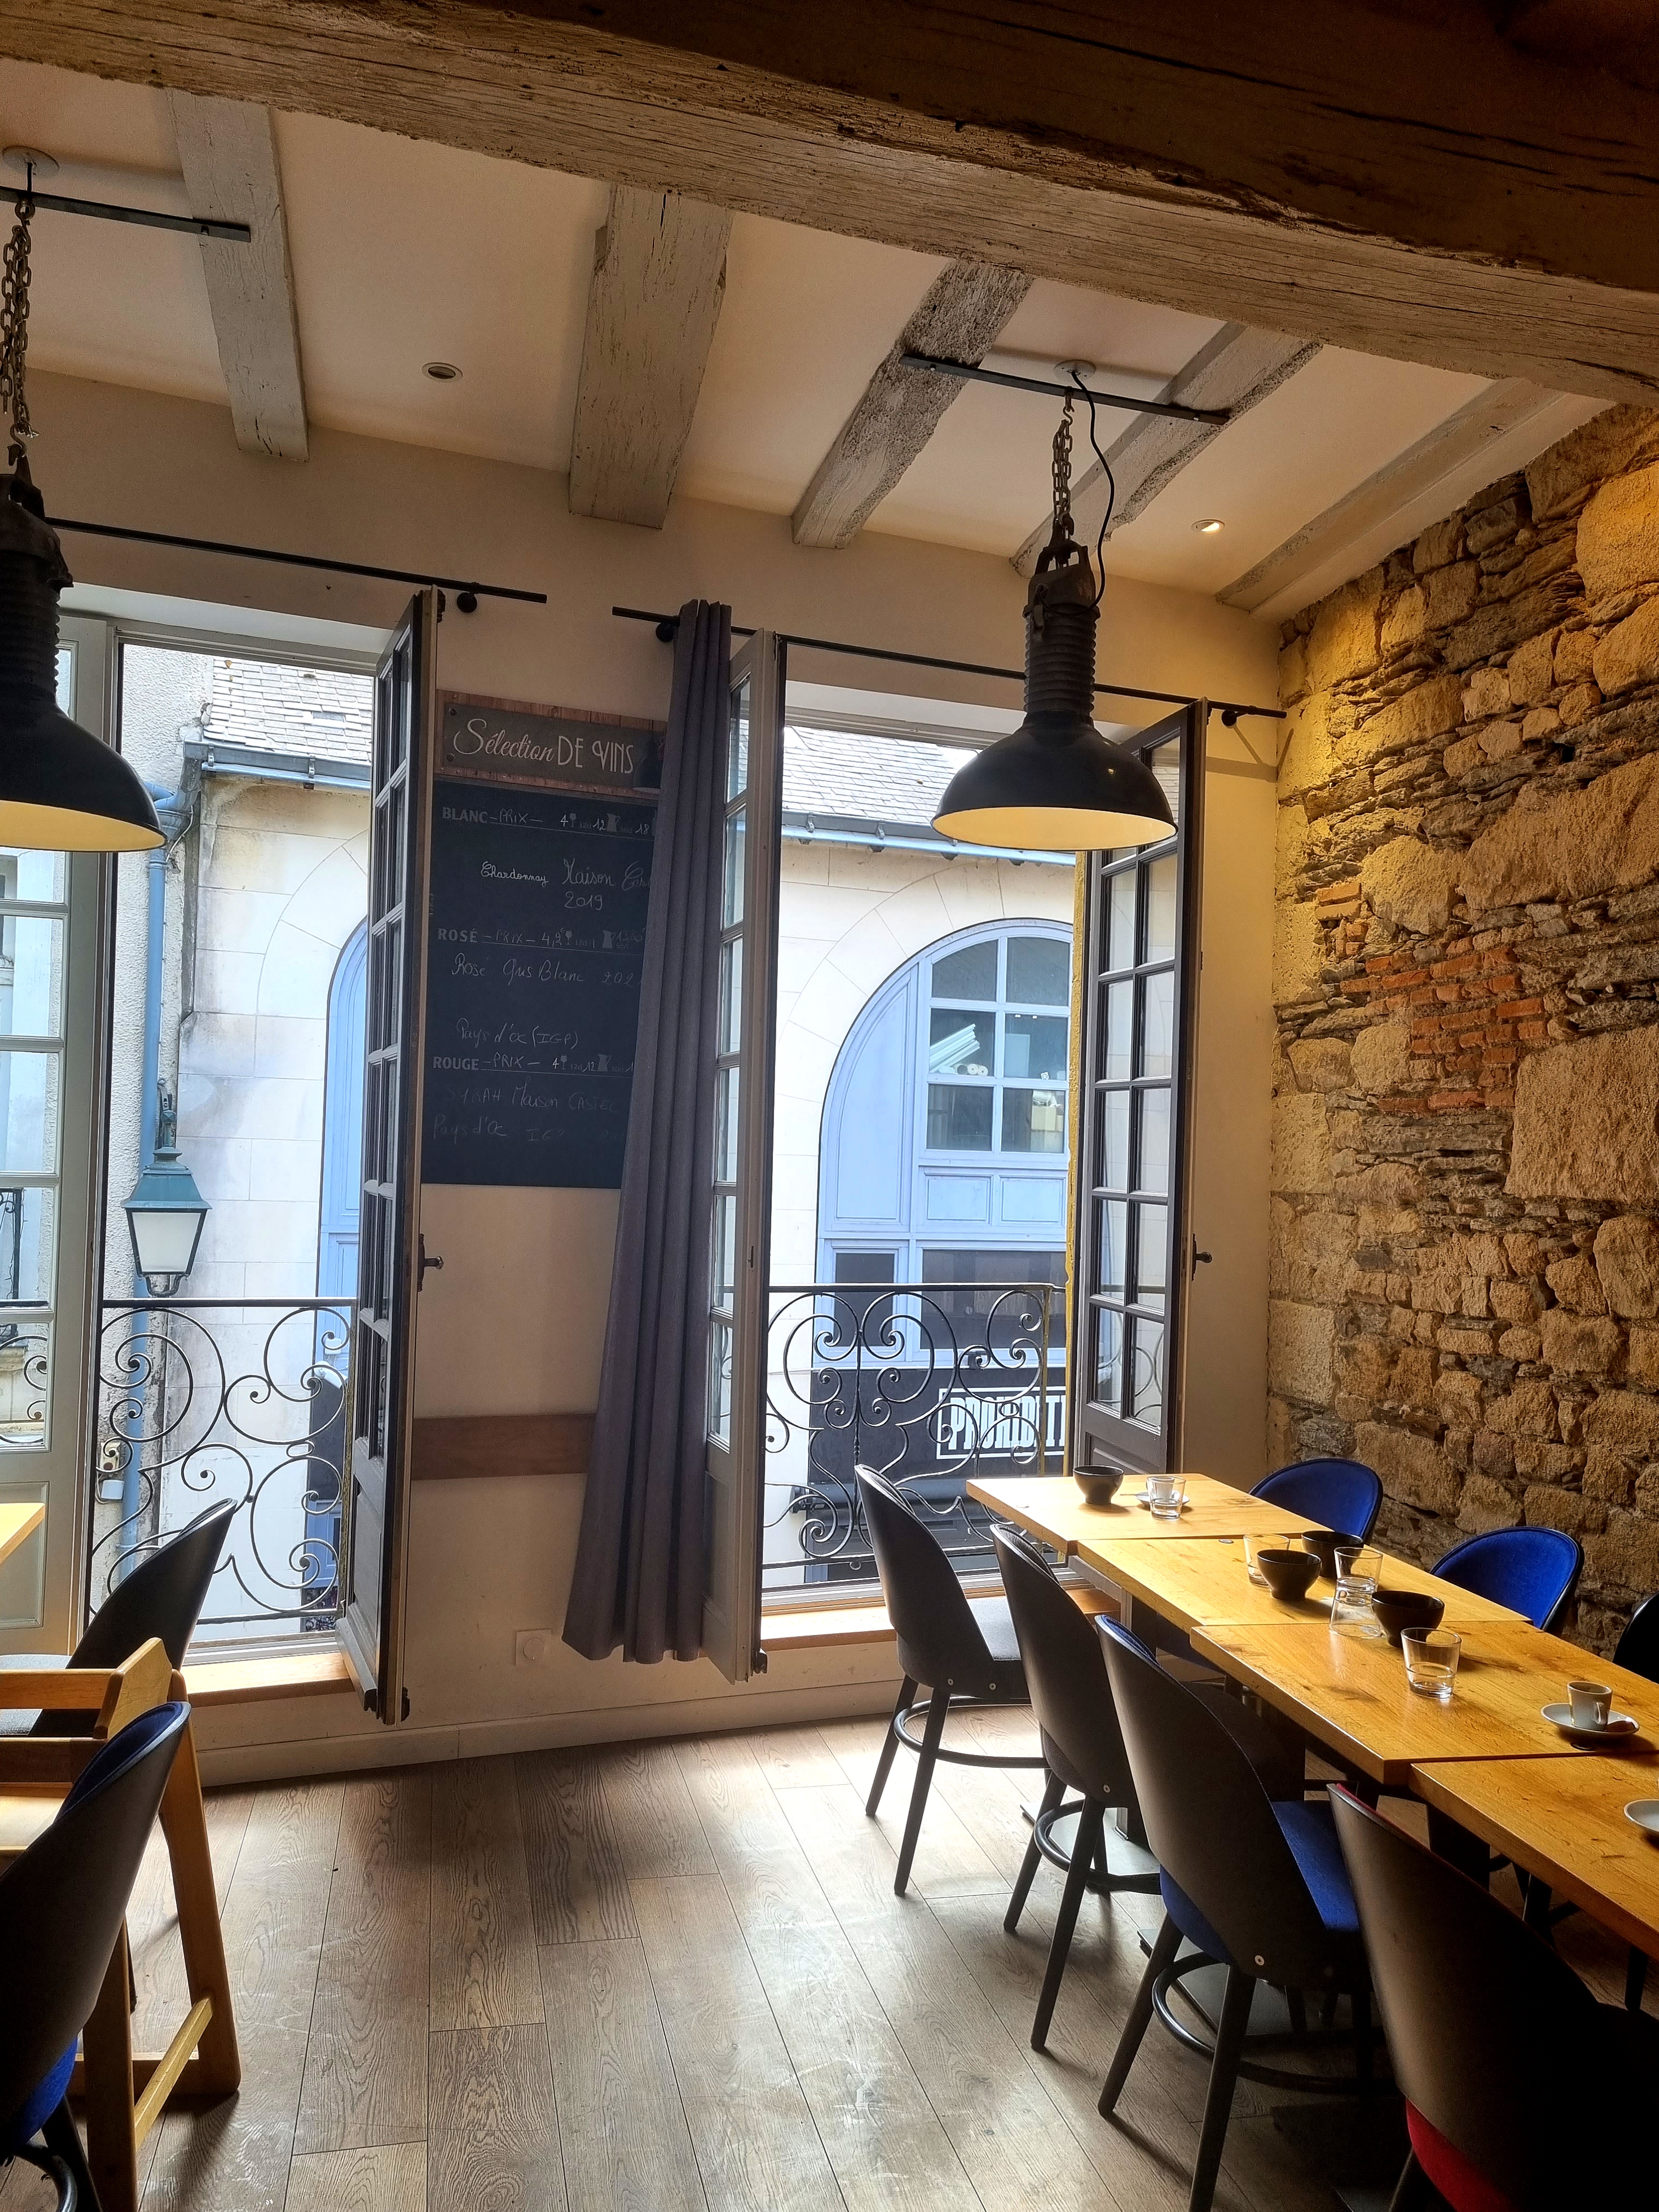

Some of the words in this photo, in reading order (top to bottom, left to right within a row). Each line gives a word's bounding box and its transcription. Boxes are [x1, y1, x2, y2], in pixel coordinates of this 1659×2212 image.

[453, 718, 555, 762] Sélection
[557, 735, 584, 768] DE
[591, 740, 634, 775] VINS
[442, 806, 488, 823] BLANC
[592, 818, 607, 831] 12
[635, 823, 650, 834] 18
[480, 860, 549, 889] Chardonnay
[563, 890, 604, 911] 2019
[437, 927, 478, 943] ROSÉ
[538, 960, 586, 982] Blanc
[432, 1056, 479, 1070] ROUGE
[493, 1052, 524, 1069] PRIX
[582, 1061, 597, 1072] 12
